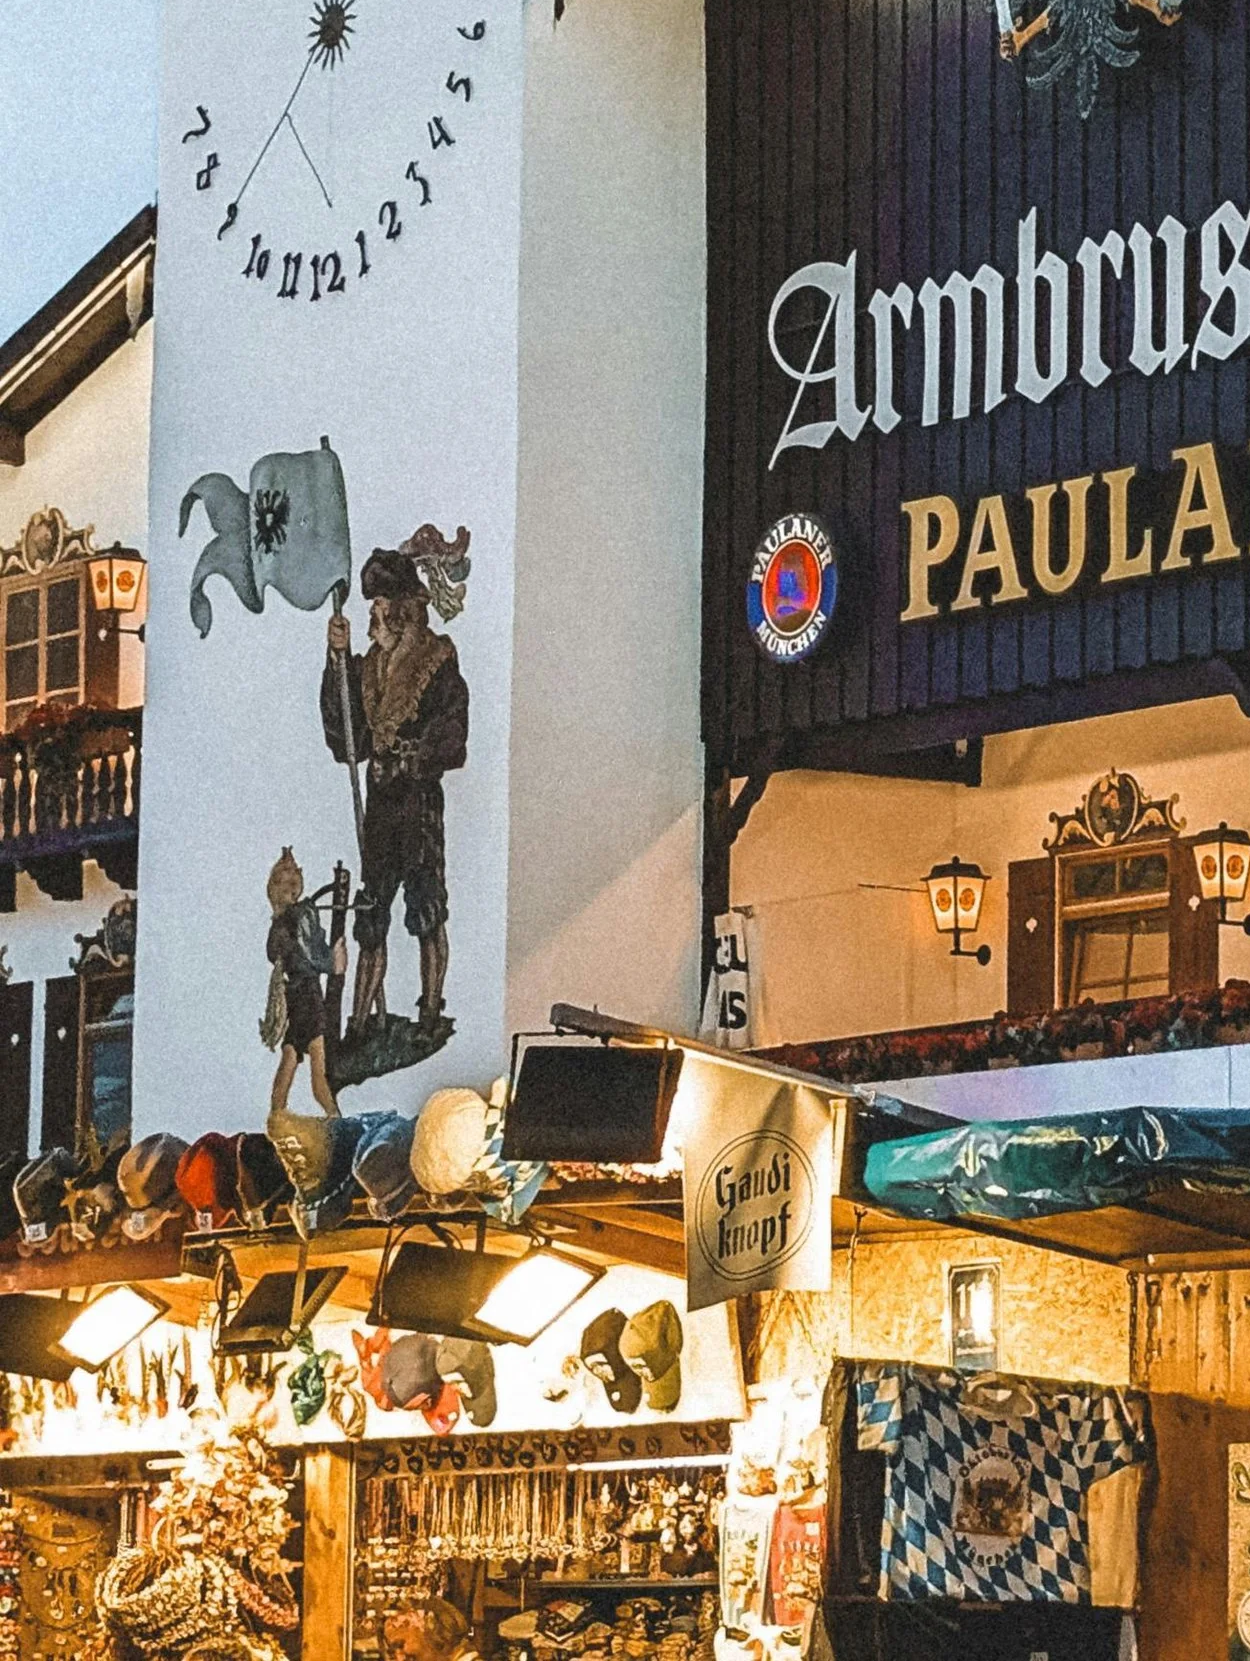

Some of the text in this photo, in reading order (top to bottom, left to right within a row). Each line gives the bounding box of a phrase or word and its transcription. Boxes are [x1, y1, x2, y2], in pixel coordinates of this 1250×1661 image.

[241, 233, 271, 281] 10
[276, 252, 303, 300] 11
[309, 250, 346, 302] 12
[378, 200, 402, 242] 2
[405, 161, 433, 207] 3
[427, 116, 456, 150] 4
[445, 71, 471, 103] 5
[751, 517, 833, 584] PAULANER
[715, 1151, 791, 1217] Gaudi
[718, 1200, 792, 1259] knopf
